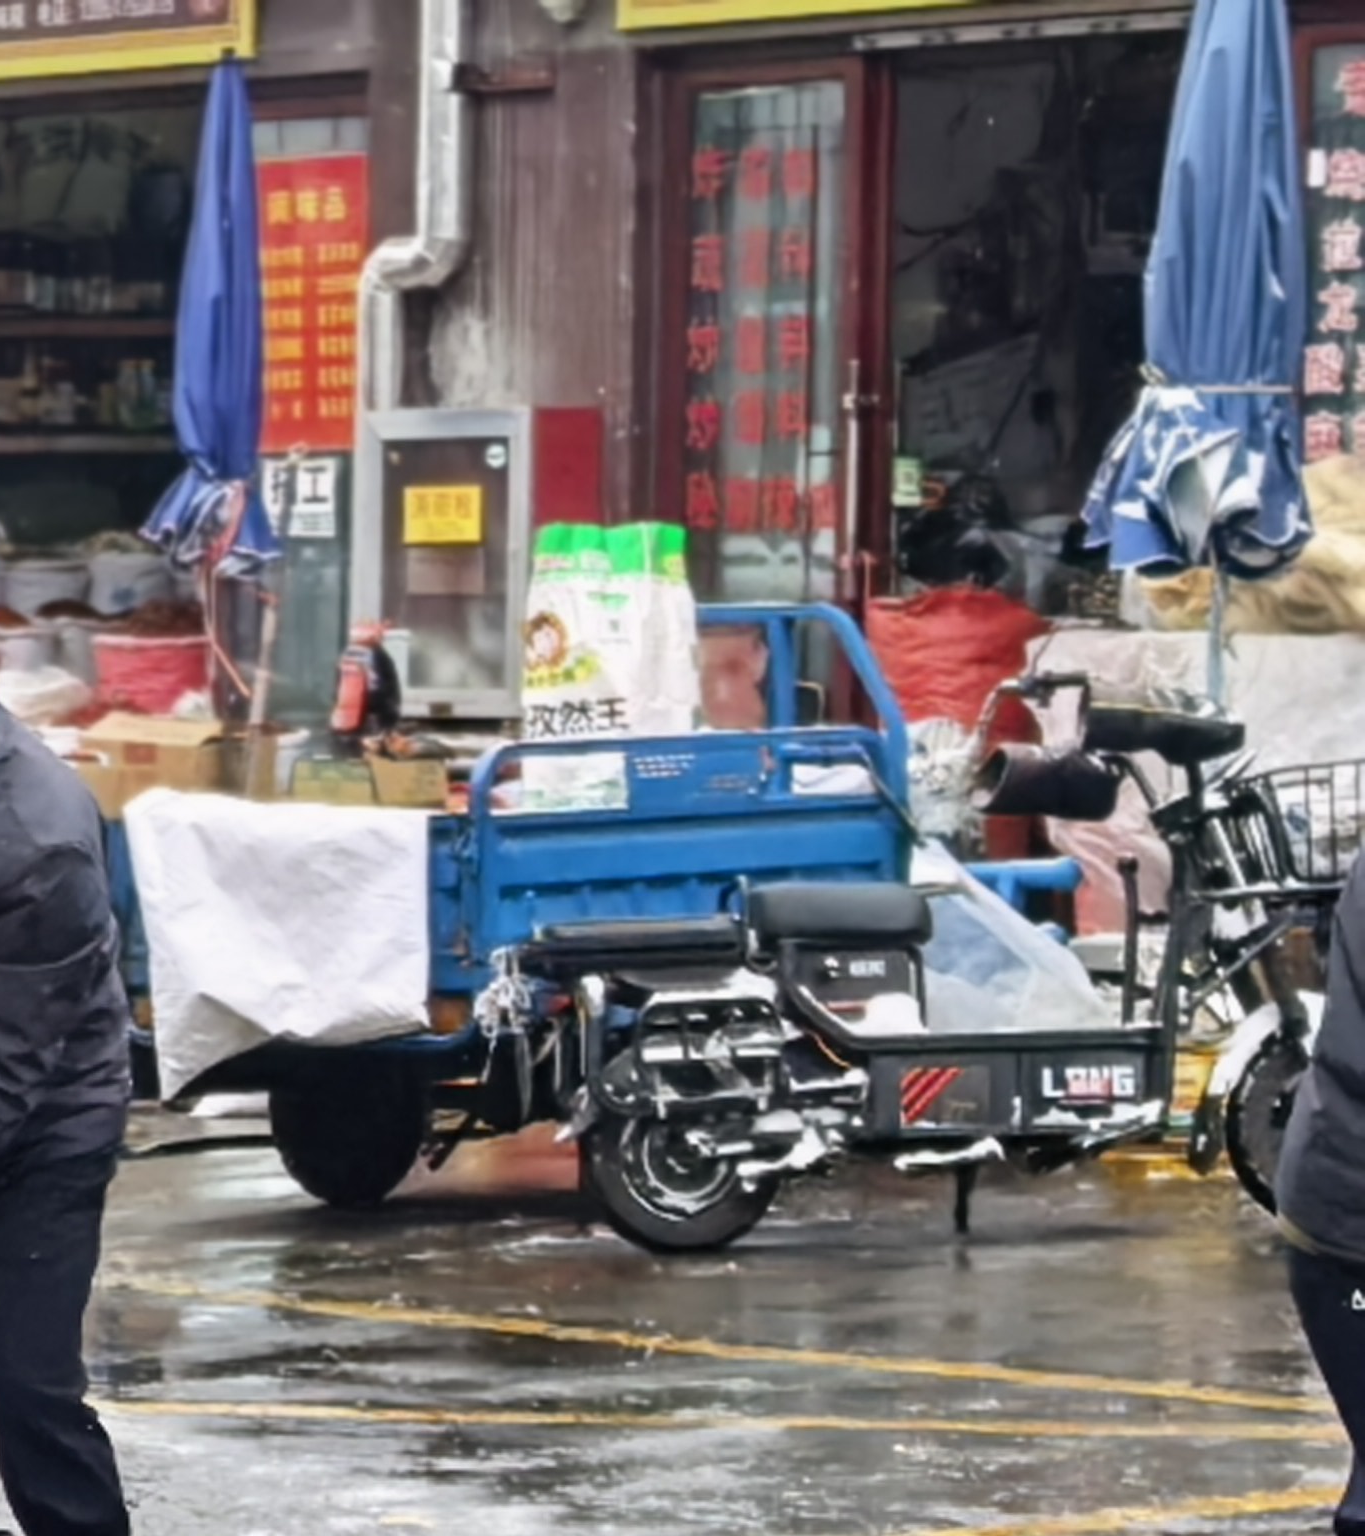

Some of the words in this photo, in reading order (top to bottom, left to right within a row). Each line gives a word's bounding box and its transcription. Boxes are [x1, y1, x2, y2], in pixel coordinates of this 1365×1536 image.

[267, 185, 347, 226] 调味品
[528, 697, 631, 739] 孜然王
